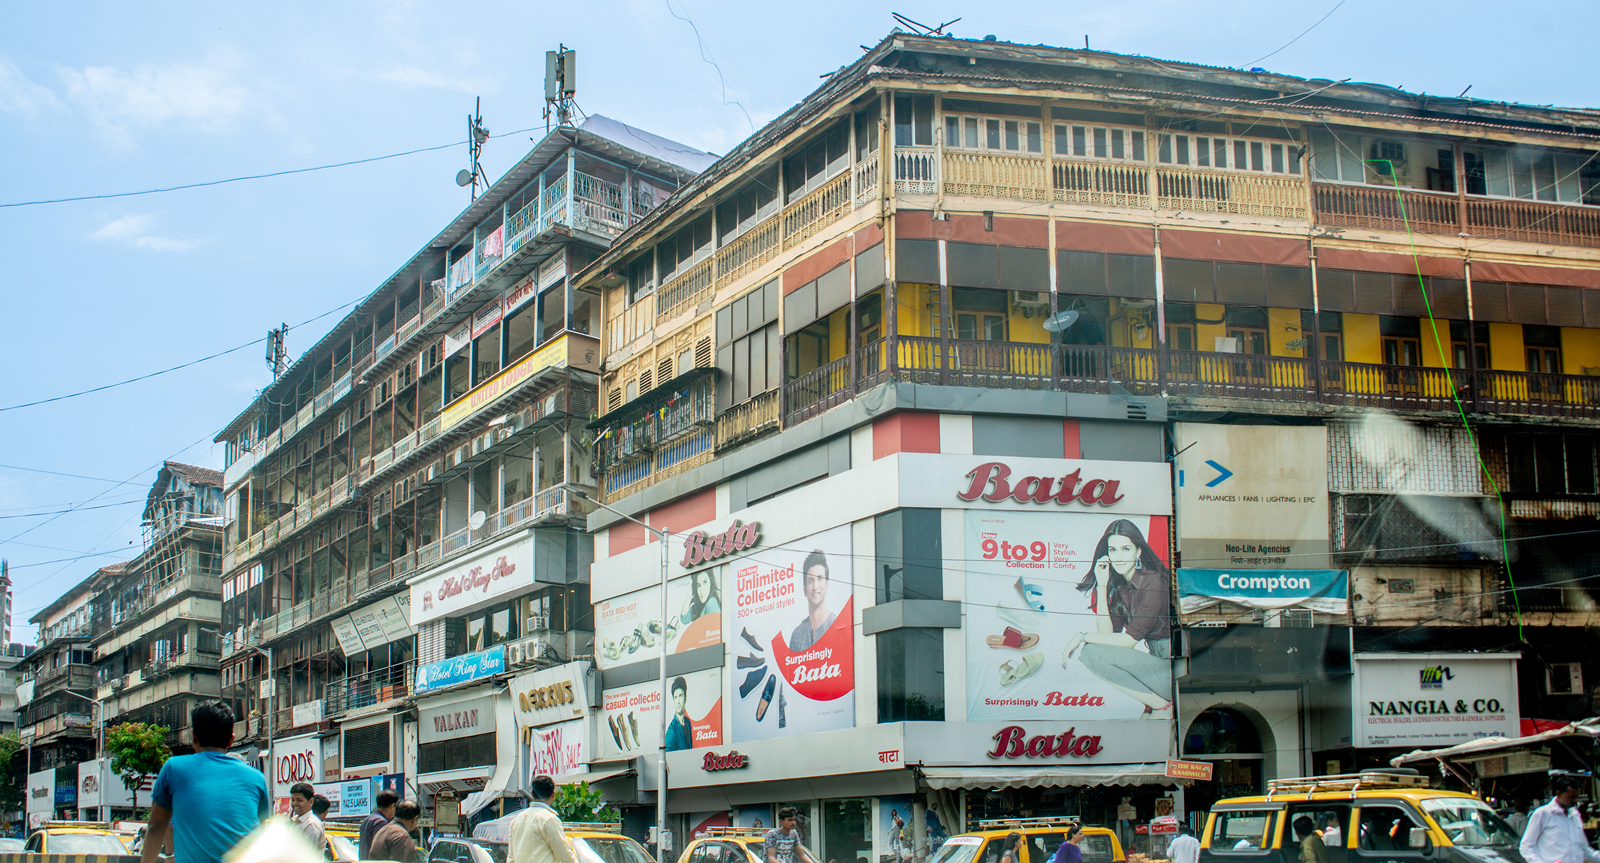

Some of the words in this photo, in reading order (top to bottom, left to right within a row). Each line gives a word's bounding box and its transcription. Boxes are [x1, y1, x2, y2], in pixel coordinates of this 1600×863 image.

[471, 381, 499, 409] UNITED
[501, 357, 534, 391] LODGE
[957, 462, 1125, 507] Bata
[680, 519, 763, 569] Bata
[1053, 542, 1069, 550] Very
[1053, 549, 1077, 557] Stylish.
[1225, 544, 1256, 553] Neo-Lite
[1257, 544, 1291, 554] Agencies
[1006, 561, 1045, 569] Collection
[438, 575, 464, 600] Hotel
[463, 565, 491, 593] King
[491, 556, 516, 581] Star
[737, 563, 794, 593] Unlimited
[1217, 574, 1311, 593] Crompton
[737, 582, 795, 607] Collection
[602, 610, 615, 619] BATA
[615, 606, 626, 615] RED
[626, 603, 637, 611] HOT
[738, 608, 753, 618] 500+
[754, 600, 775, 614] casual
[776, 597, 796, 609] styles
[602, 611, 638, 627] COLLECTION
[785, 647, 832, 665] Surprisingly
[428, 662, 454, 686] Hotel
[453, 658, 478, 679] King
[480, 653, 501, 674] Star
[791, 661, 842, 685] Bata
[605, 696, 628, 711] casual
[630, 690, 661, 706] collectio
[985, 698, 1039, 707] Surprisingly
[1042, 691, 1105, 707] Bata
[1369, 700, 1450, 715] NANGIA
[1454, 699, 1468, 713] &
[1473, 699, 1505, 713] CO.
[433, 709, 479, 733] VALKAN
[695, 730, 718, 741] Bata
[986, 725, 1104, 759] Bata
[277, 749, 316, 784] LORD'S
[533, 750, 548, 775] ALE
[566, 743, 581, 768] SALE
[701, 750, 748, 771] Bata
[878, 750, 899, 763] बाटा
